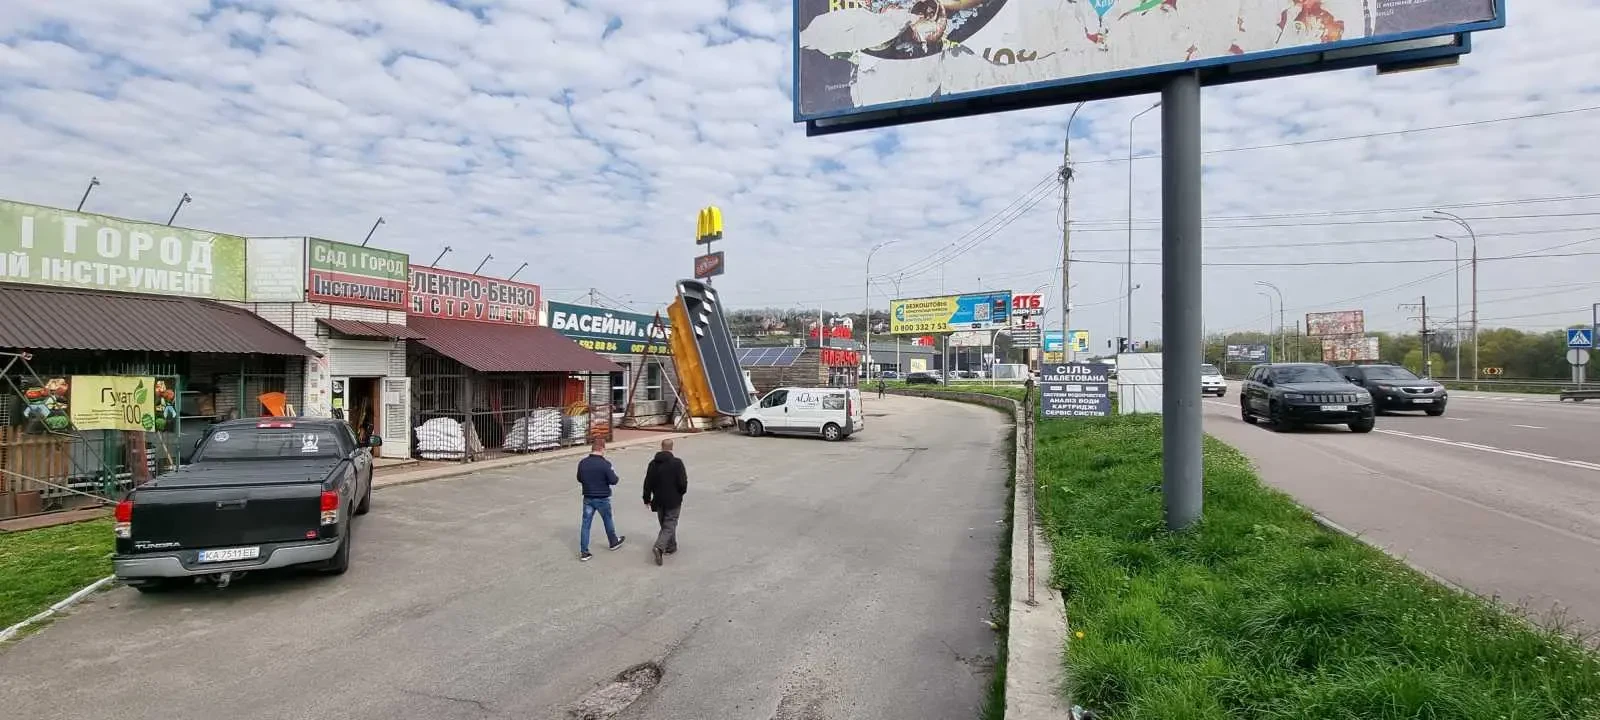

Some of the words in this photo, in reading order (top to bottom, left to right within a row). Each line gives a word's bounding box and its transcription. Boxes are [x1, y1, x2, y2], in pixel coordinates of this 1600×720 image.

[314, 245, 346, 269] САД
[361, 253, 404, 277] ГОРОД
[41, 257, 213, 294] ІНСТРУМЕНТ
[313, 274, 404, 304] ІНСТРУМЕНТ
[552, 311, 637, 336] БАСЕЙНИ
[1043, 374, 1105, 382] ТАБЛЕТОВАНА
[1056, 365, 1091, 374] СІЛЬ
[121, 404, 141, 425] 100
[135, 541, 181, 550] TUNDRA
